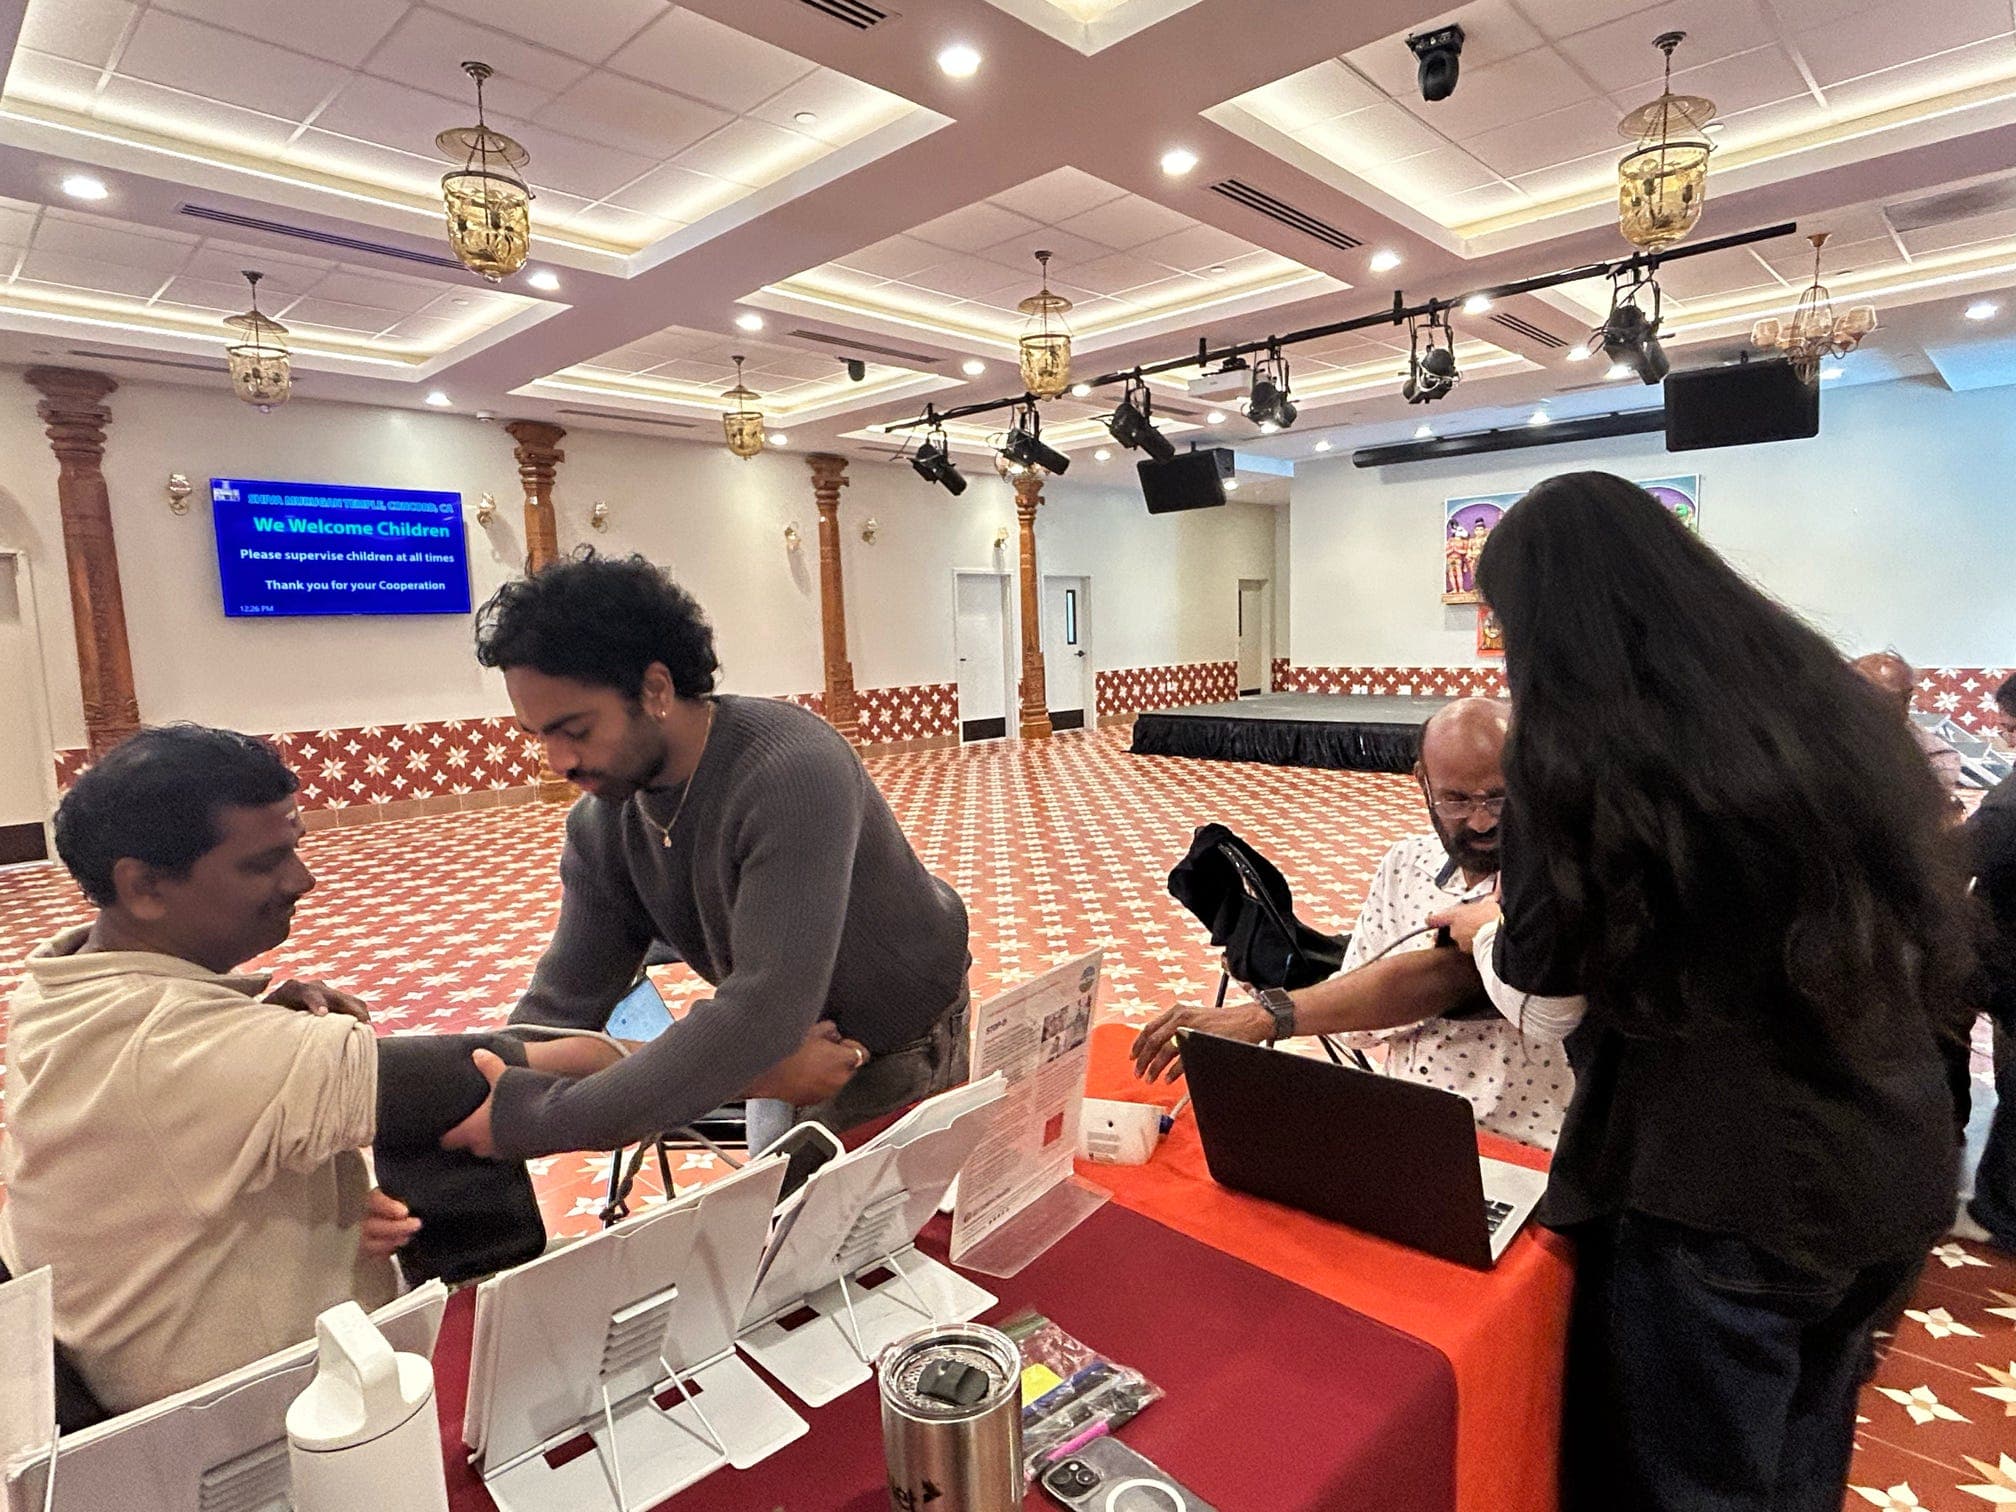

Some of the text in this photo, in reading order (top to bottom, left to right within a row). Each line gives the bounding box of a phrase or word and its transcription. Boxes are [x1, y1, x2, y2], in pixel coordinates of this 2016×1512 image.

[253, 516, 450, 538] We Welcome Children
[240, 548, 455, 563] Please supervise children at all times
[264, 579, 446, 592] Thank you for your Cooperation
